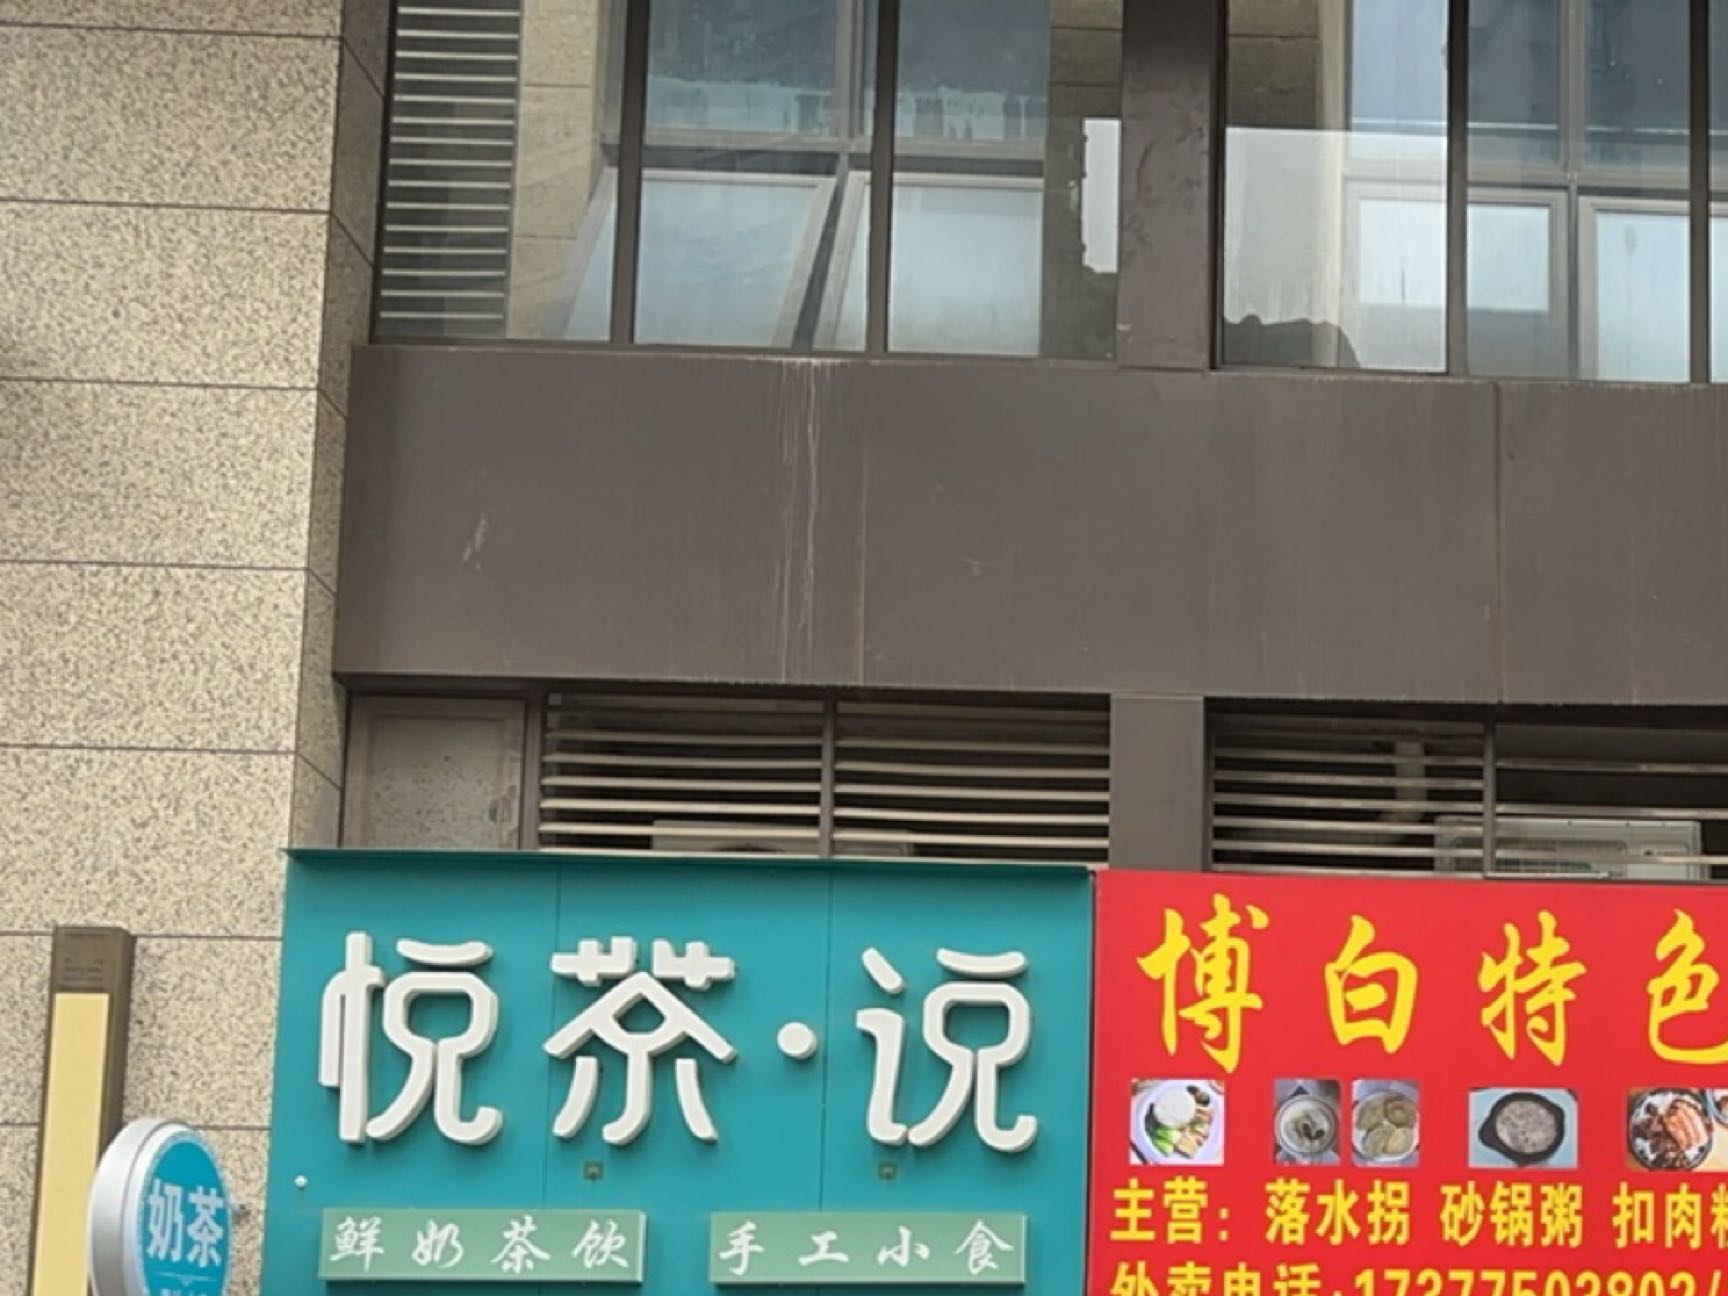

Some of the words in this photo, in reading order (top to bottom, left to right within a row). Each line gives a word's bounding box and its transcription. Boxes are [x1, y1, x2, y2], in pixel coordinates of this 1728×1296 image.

[146, 1178, 224, 1268] 奶茶
[328, 1214, 631, 1274] 鲜奶茶饮
[719, 1218, 1015, 1274] 手工小食
[1265, 1177, 1410, 1246] 落水拐
[1440, 1181, 1585, 1249] 砂锅粥
